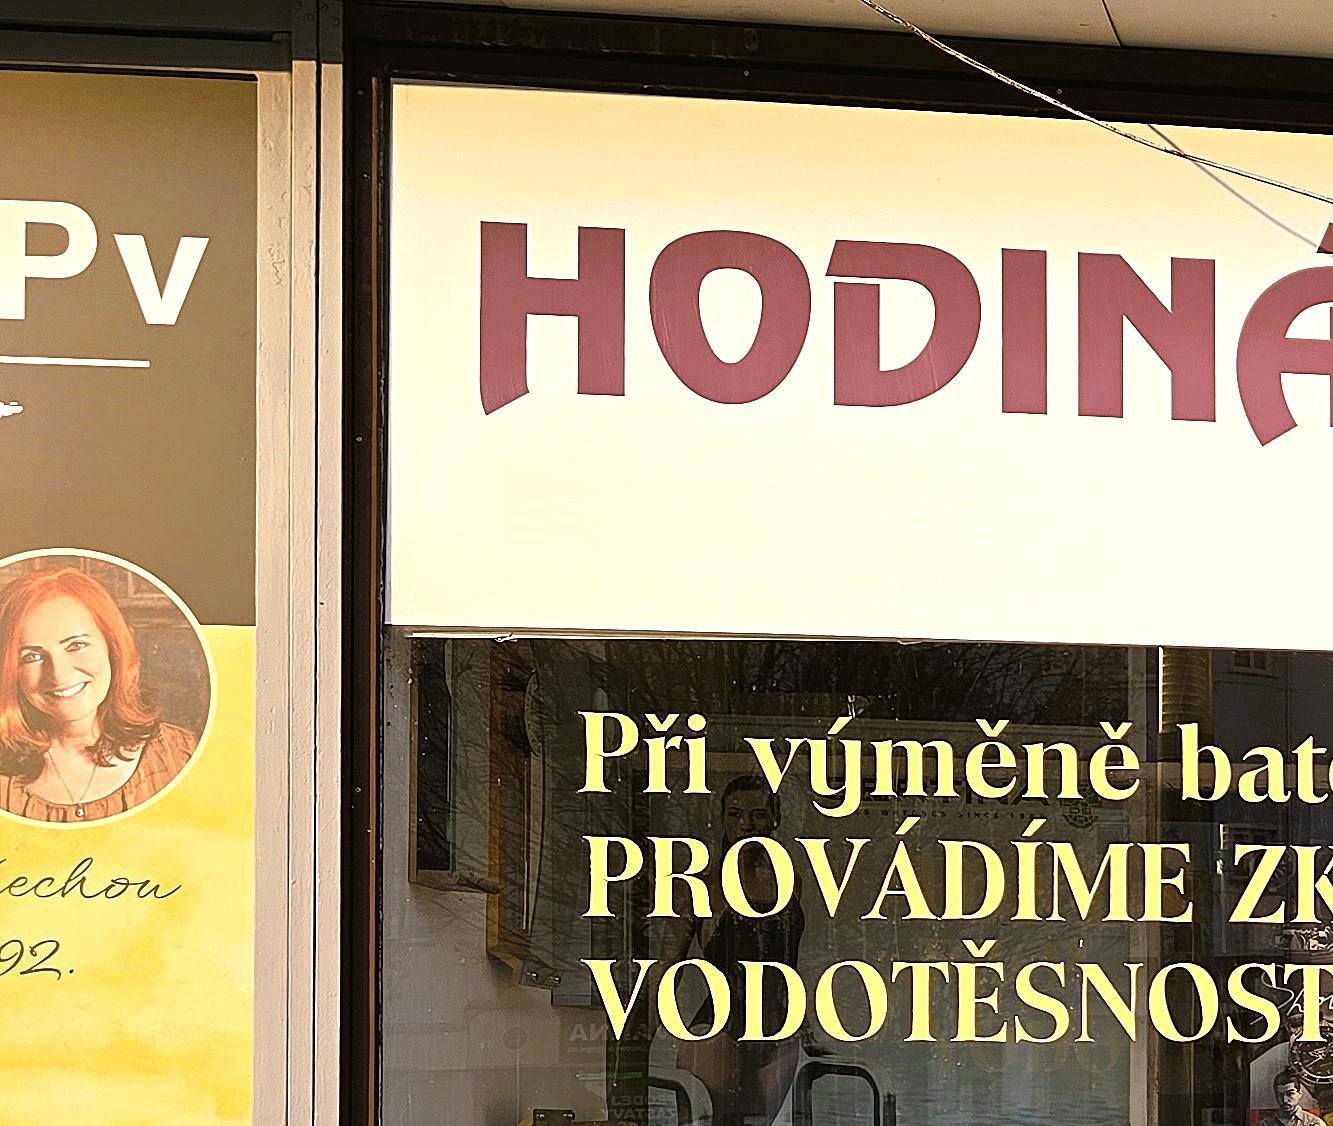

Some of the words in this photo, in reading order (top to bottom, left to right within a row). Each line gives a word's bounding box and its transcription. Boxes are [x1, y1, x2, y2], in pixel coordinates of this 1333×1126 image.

[577, 710, 711, 795] Při
[744, 715, 1141, 818] výměně
[0, 855, 182, 899] echou
[580, 817, 1193, 924] PROVÁDÍME
